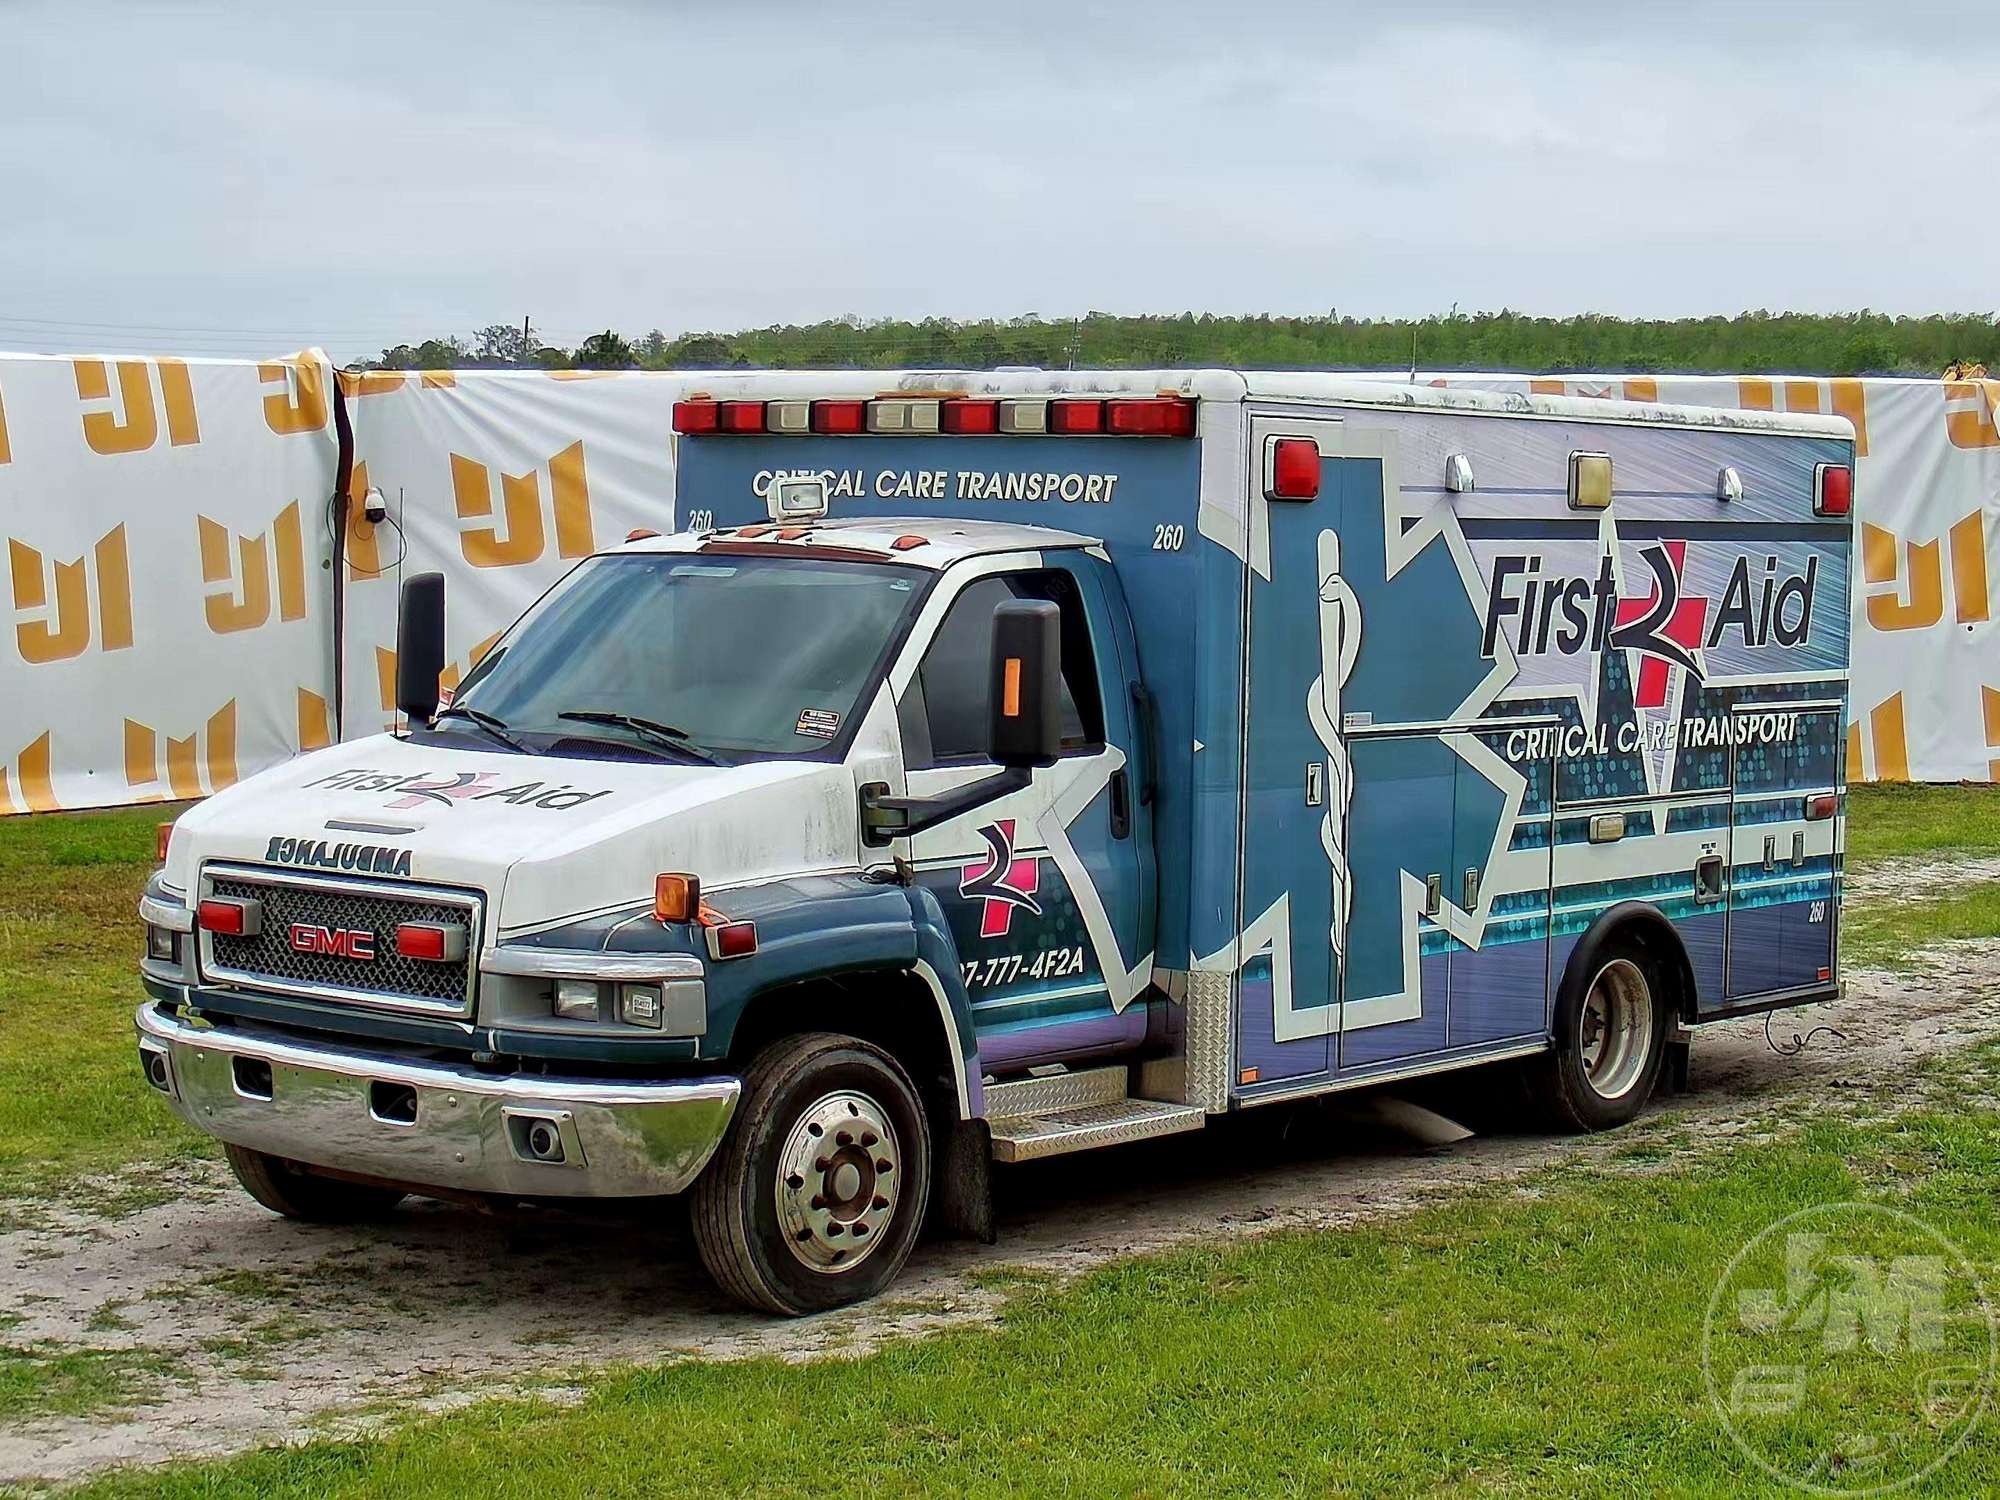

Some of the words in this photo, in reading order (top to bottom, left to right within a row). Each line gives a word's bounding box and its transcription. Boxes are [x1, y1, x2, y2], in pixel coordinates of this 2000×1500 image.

[752, 470, 866, 497] CCAL
[875, 470, 948, 498] CARE
[956, 472, 1118, 502] TRANSPORT
[688, 509, 712, 532] 260
[1152, 523, 1184, 551] 260
[1480, 555, 1617, 658] First
[1706, 554, 1819, 649] Aid
[1506, 723, 1609, 762] CRITICAL
[1617, 718, 1677, 753] CARE
[1682, 712, 1799, 748] TRANSPORT
[301, 769, 432, 792] First
[470, 781, 614, 810] Aid
[1808, 901, 1825, 922] 260
[290, 922, 375, 960] GMC
[960, 946, 1084, 989] 7-777-4F2A
